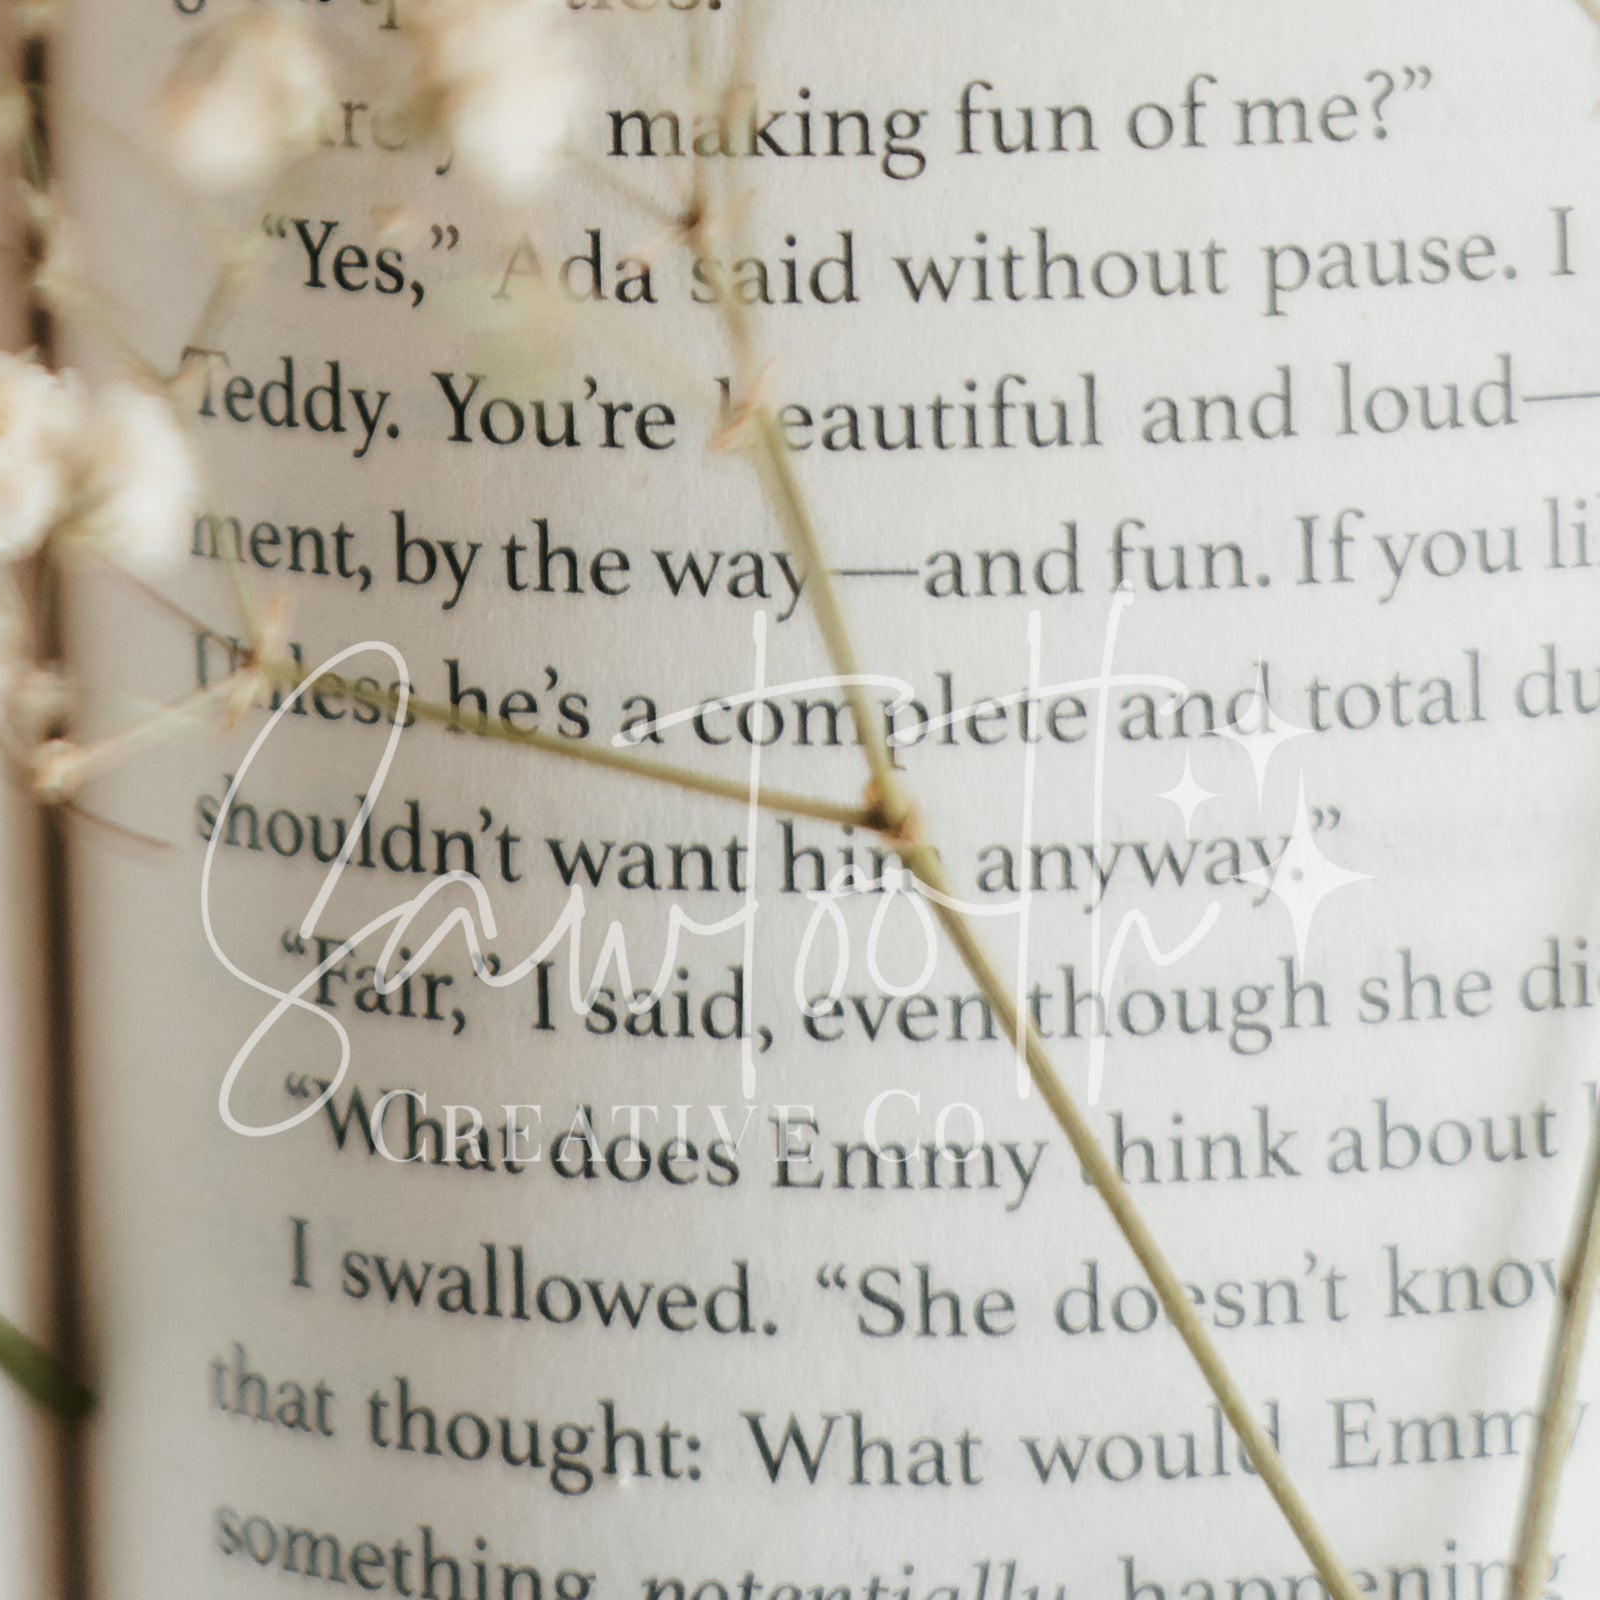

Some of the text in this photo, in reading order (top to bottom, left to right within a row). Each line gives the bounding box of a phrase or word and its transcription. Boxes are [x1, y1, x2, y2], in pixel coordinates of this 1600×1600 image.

[953, 79, 1102, 157] fun
[1126, 72, 1220, 151] of
[1233, 63, 1435, 148] me?”
[260, 211, 461, 309] “Yes,”
[689, 229, 862, 304] said
[891, 227, 1231, 304] without
[1260, 232, 1519, 318] pause.
[1547, 205, 1578, 278] I
[180, 345, 403, 460] Teddy.
[430, 371, 678, 452] You’re
[1140, 364, 1300, 446] and
[391, 508, 484, 611] by
[500, 519, 633, 598] the
[1108, 517, 1272, 596] fun.
[1294, 508, 1366, 586] If
[1372, 526, 1524, 606] you
[443, 657, 590, 740] he’s
[619, 692, 668, 745] a
[691, 670, 1090, 771] complete
[1117, 656, 1277, 742] and
[1304, 647, 1490, 734] total
[196, 773, 523, 885] shouldn’t
[544, 830, 752, 893] want
[974, 804, 1345, 916] anyway.”
[280, 929, 502, 1037] “Fair,”
[530, 959, 557, 1032] I
[583, 962, 774, 1055] said,
[801, 988, 1002, 1045] even
[1027, 962, 1332, 1057] though
[1355, 945, 1495, 1026] she
[285, 1070, 528, 1177] “What
[550, 1104, 742, 1190] does
[768, 1115, 1051, 1213] Emmy
[1325, 1095, 1561, 1178] about
[288, 1215, 316, 1290] I
[340, 1241, 780, 1338] swallowed.
[814, 1254, 1019, 1340] “She
[208, 1341, 335, 1438] that
[366, 1375, 703, 1498] thought:
[737, 1407, 985, 1488] What
[215, 1503, 598, 1600] something
